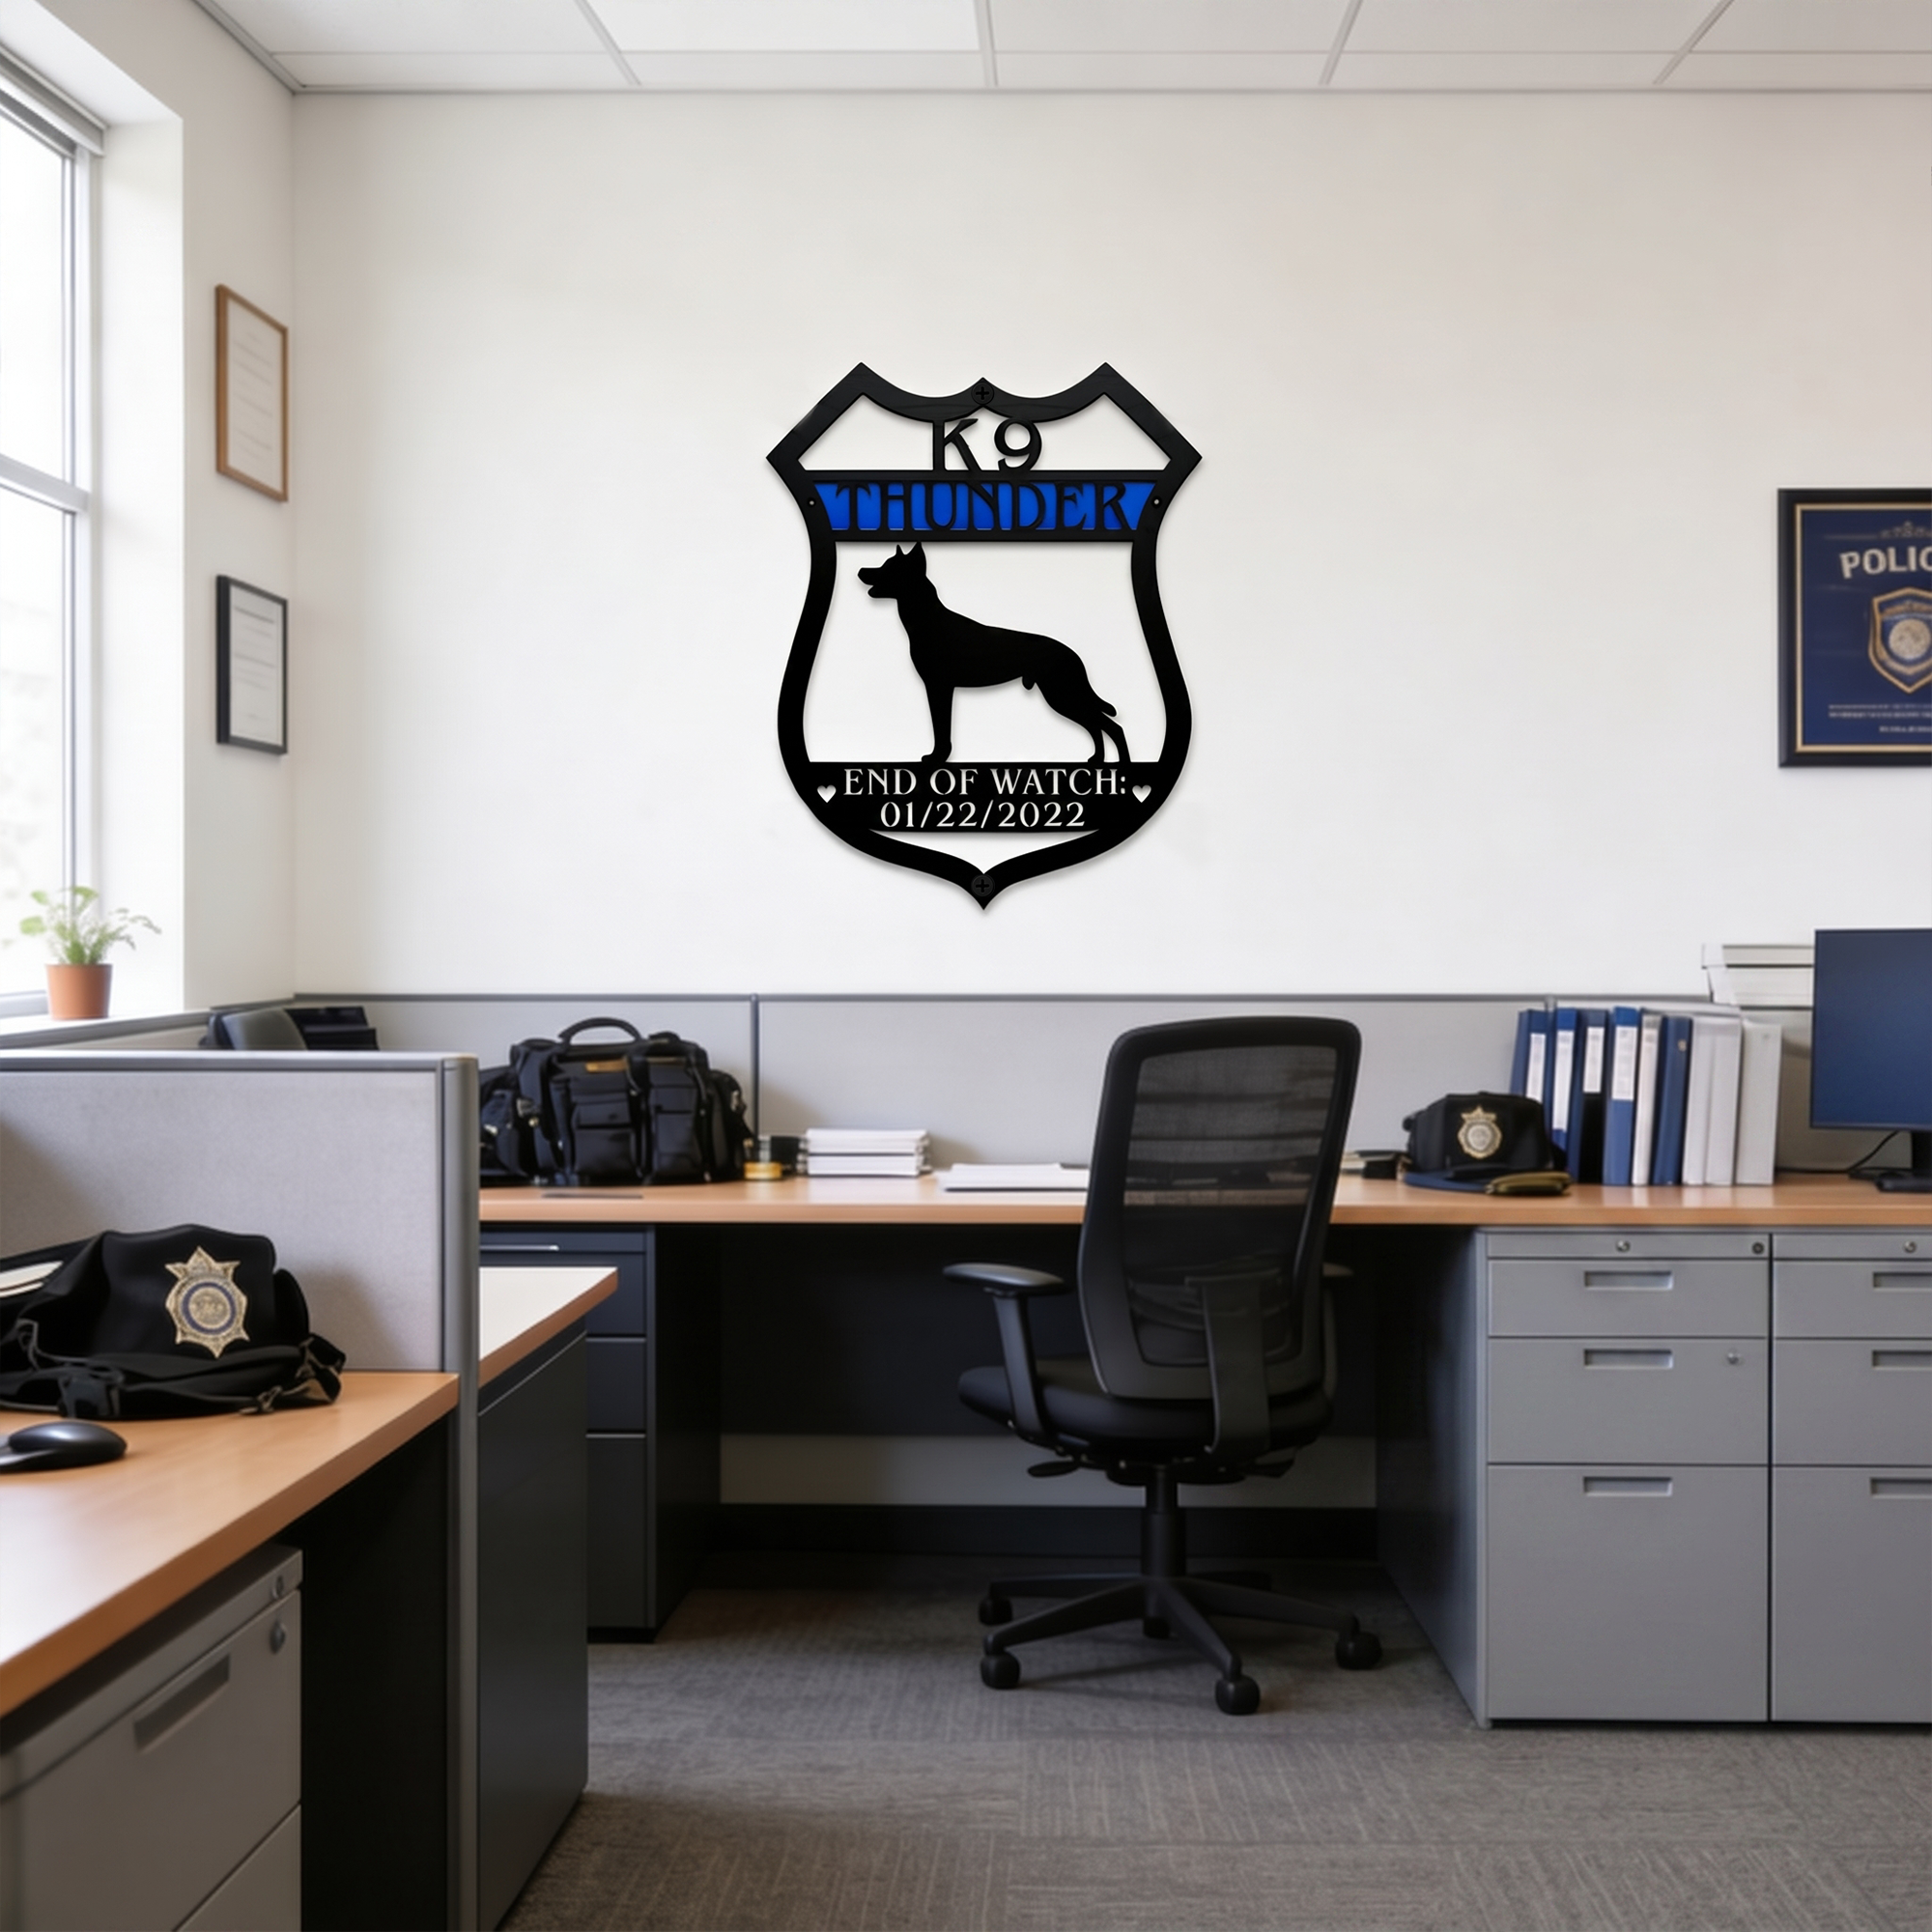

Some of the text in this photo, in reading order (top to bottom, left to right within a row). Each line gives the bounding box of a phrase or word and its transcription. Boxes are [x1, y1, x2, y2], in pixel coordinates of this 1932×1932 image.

[932, 418, 1042, 471] K9
[836, 482, 1135, 530] THUNDER
[843, 768, 1126, 796] END OF WATCH:
[880, 800, 1085, 829] 01/22/2022
